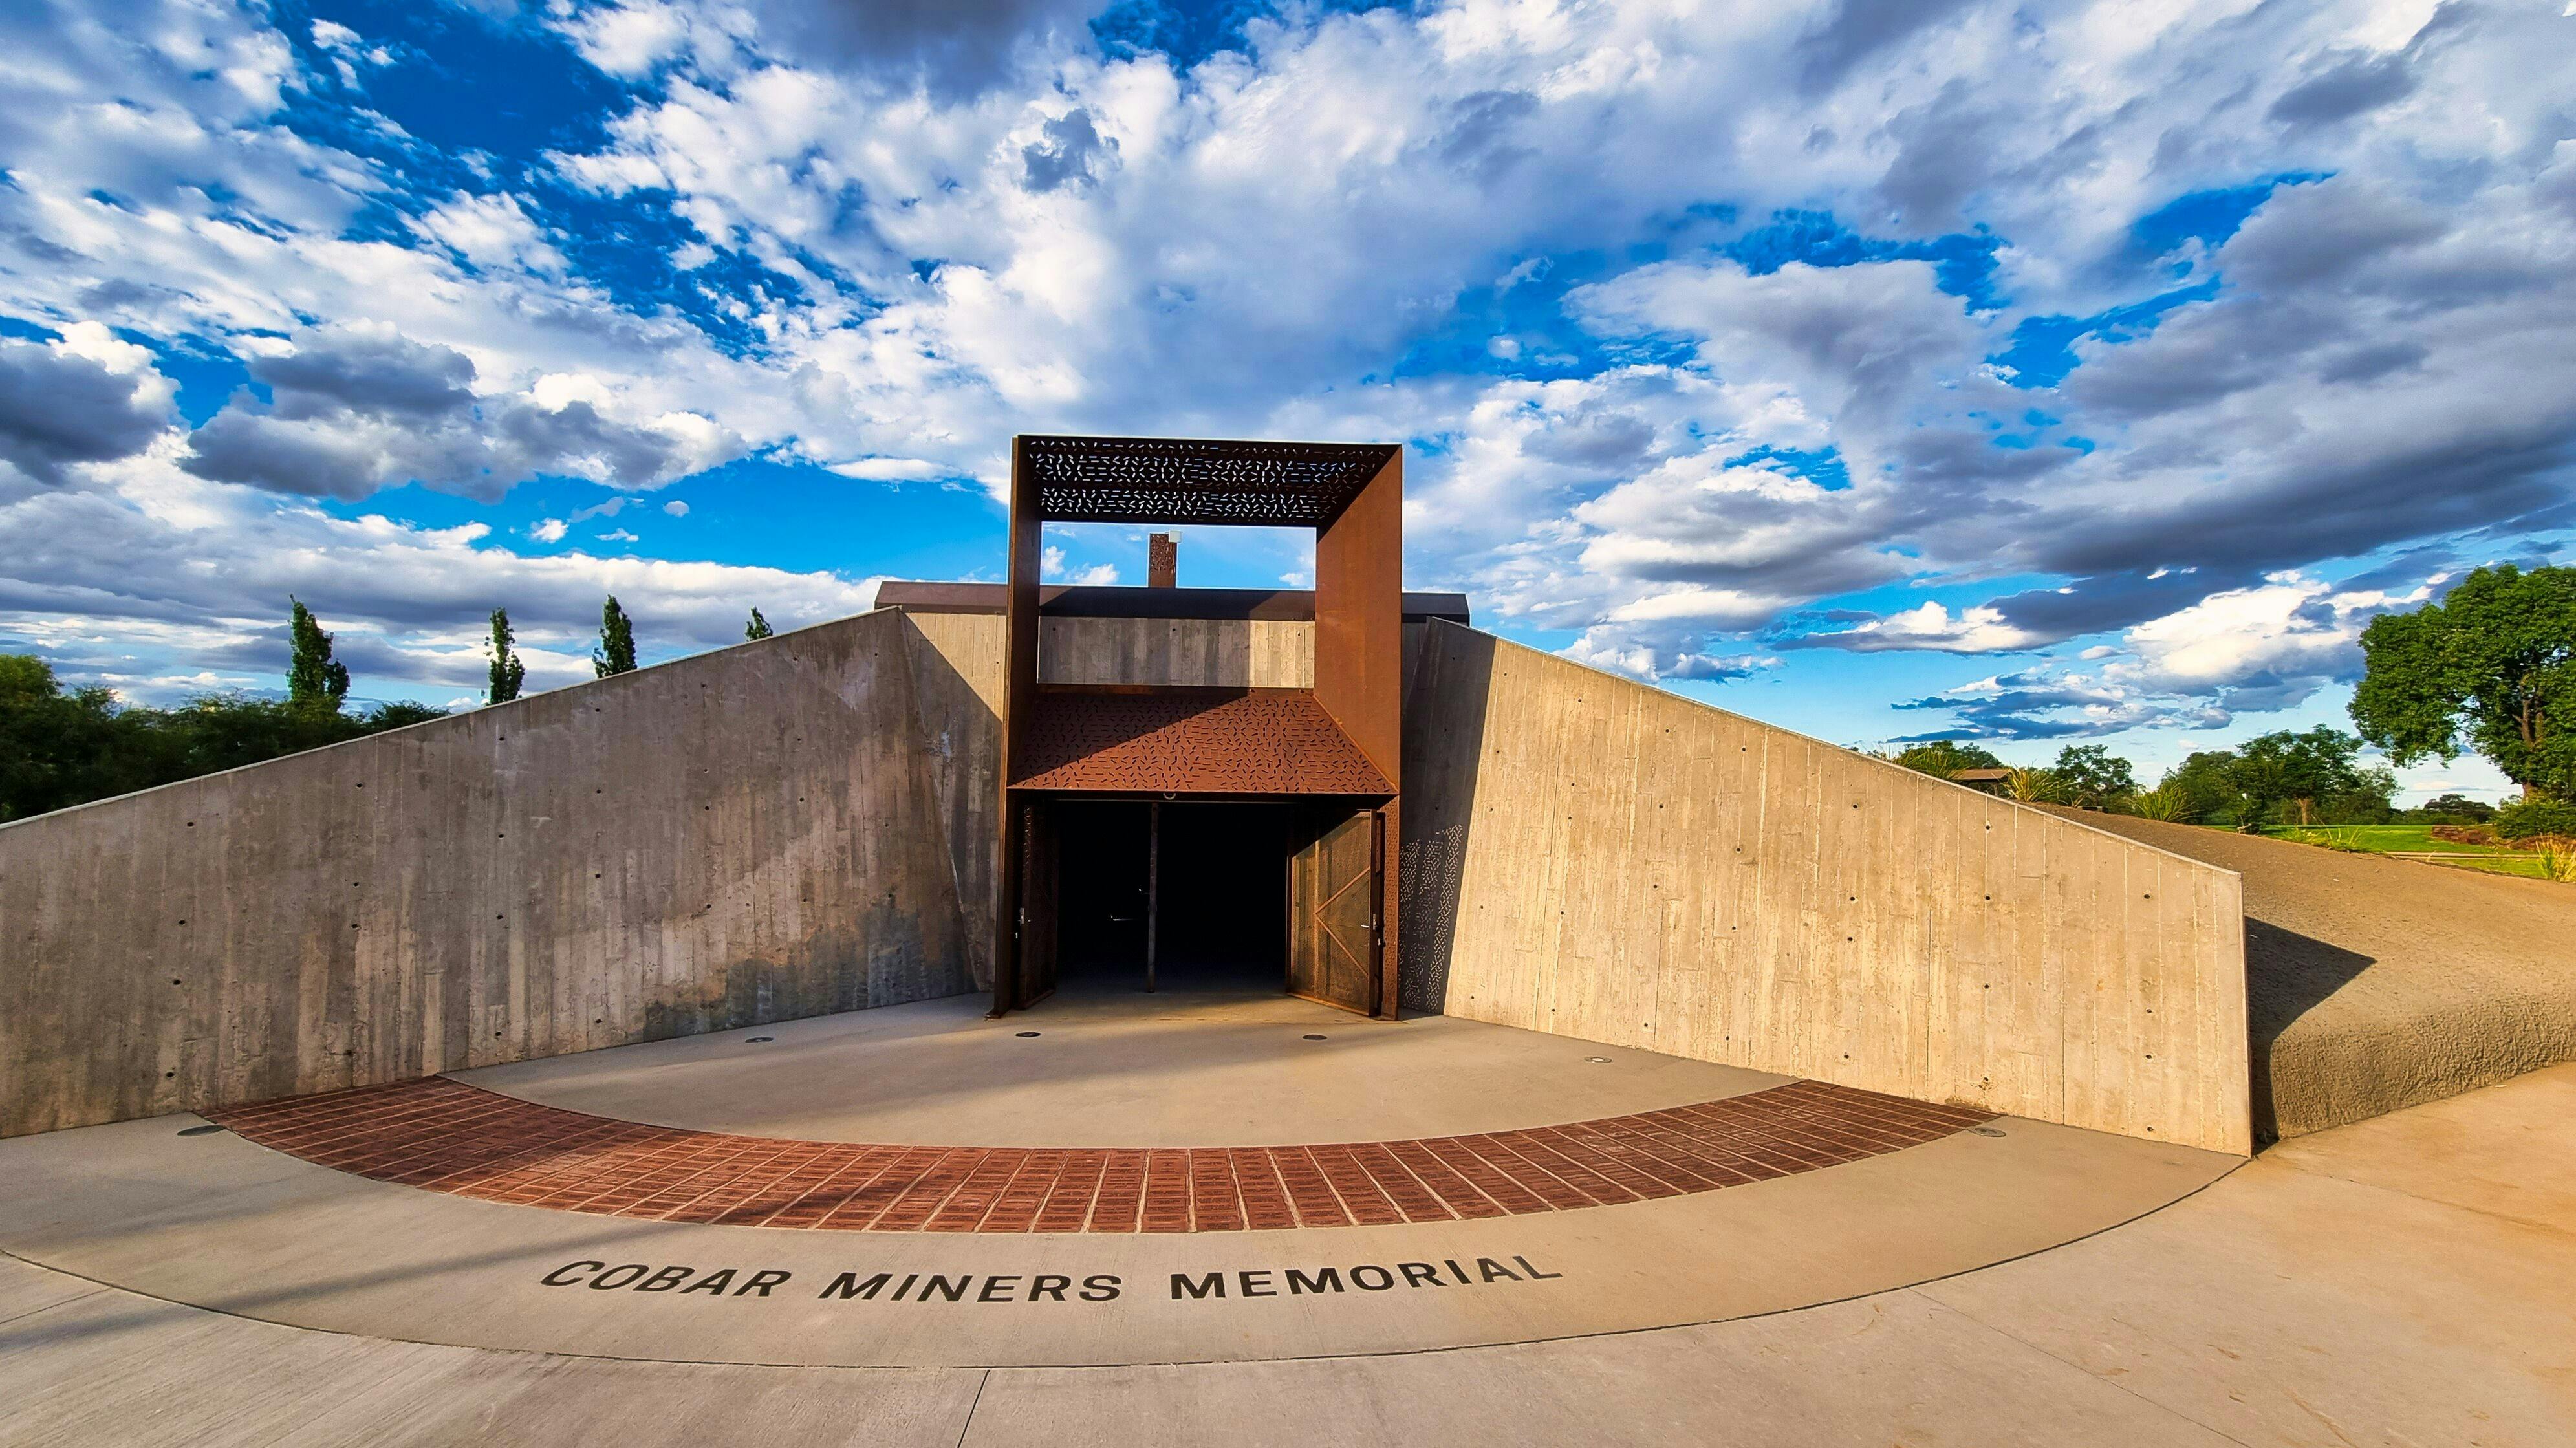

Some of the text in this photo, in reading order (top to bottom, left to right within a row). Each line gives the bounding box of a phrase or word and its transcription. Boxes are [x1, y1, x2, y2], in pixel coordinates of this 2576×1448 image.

[541, 1255, 1563, 1302] COBAR MINERS MEMORIAL
